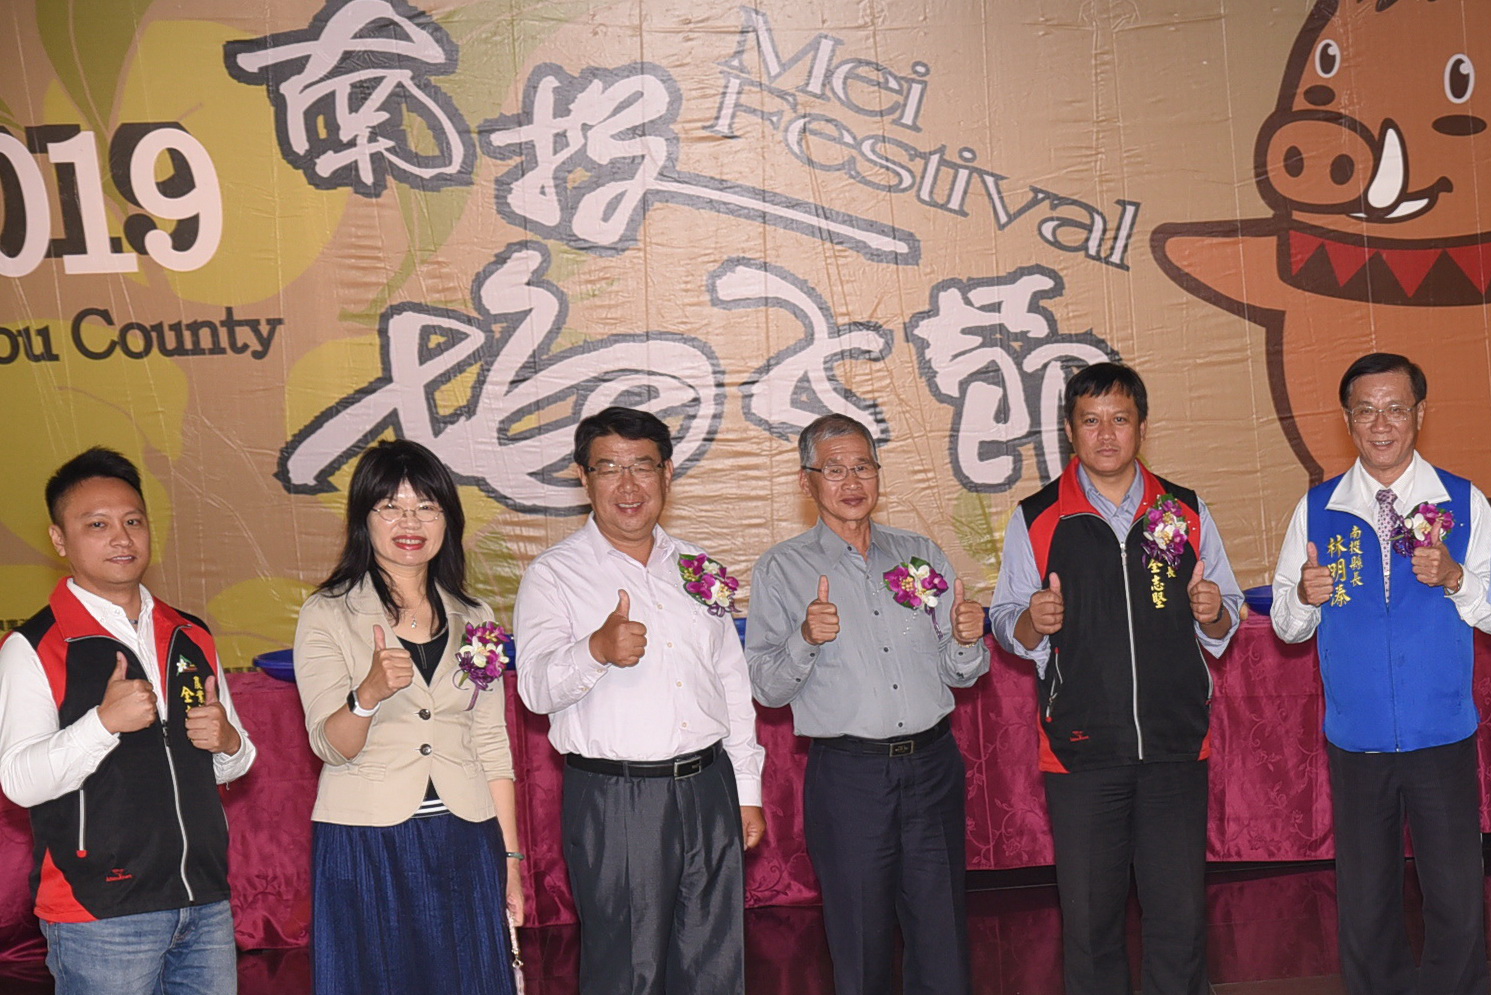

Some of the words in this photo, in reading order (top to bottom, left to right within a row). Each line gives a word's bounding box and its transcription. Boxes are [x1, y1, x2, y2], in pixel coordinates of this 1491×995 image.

[715, 5, 932, 132] Mei
[702, 68, 1141, 272] Festival
[71, 306, 285, 361] County
